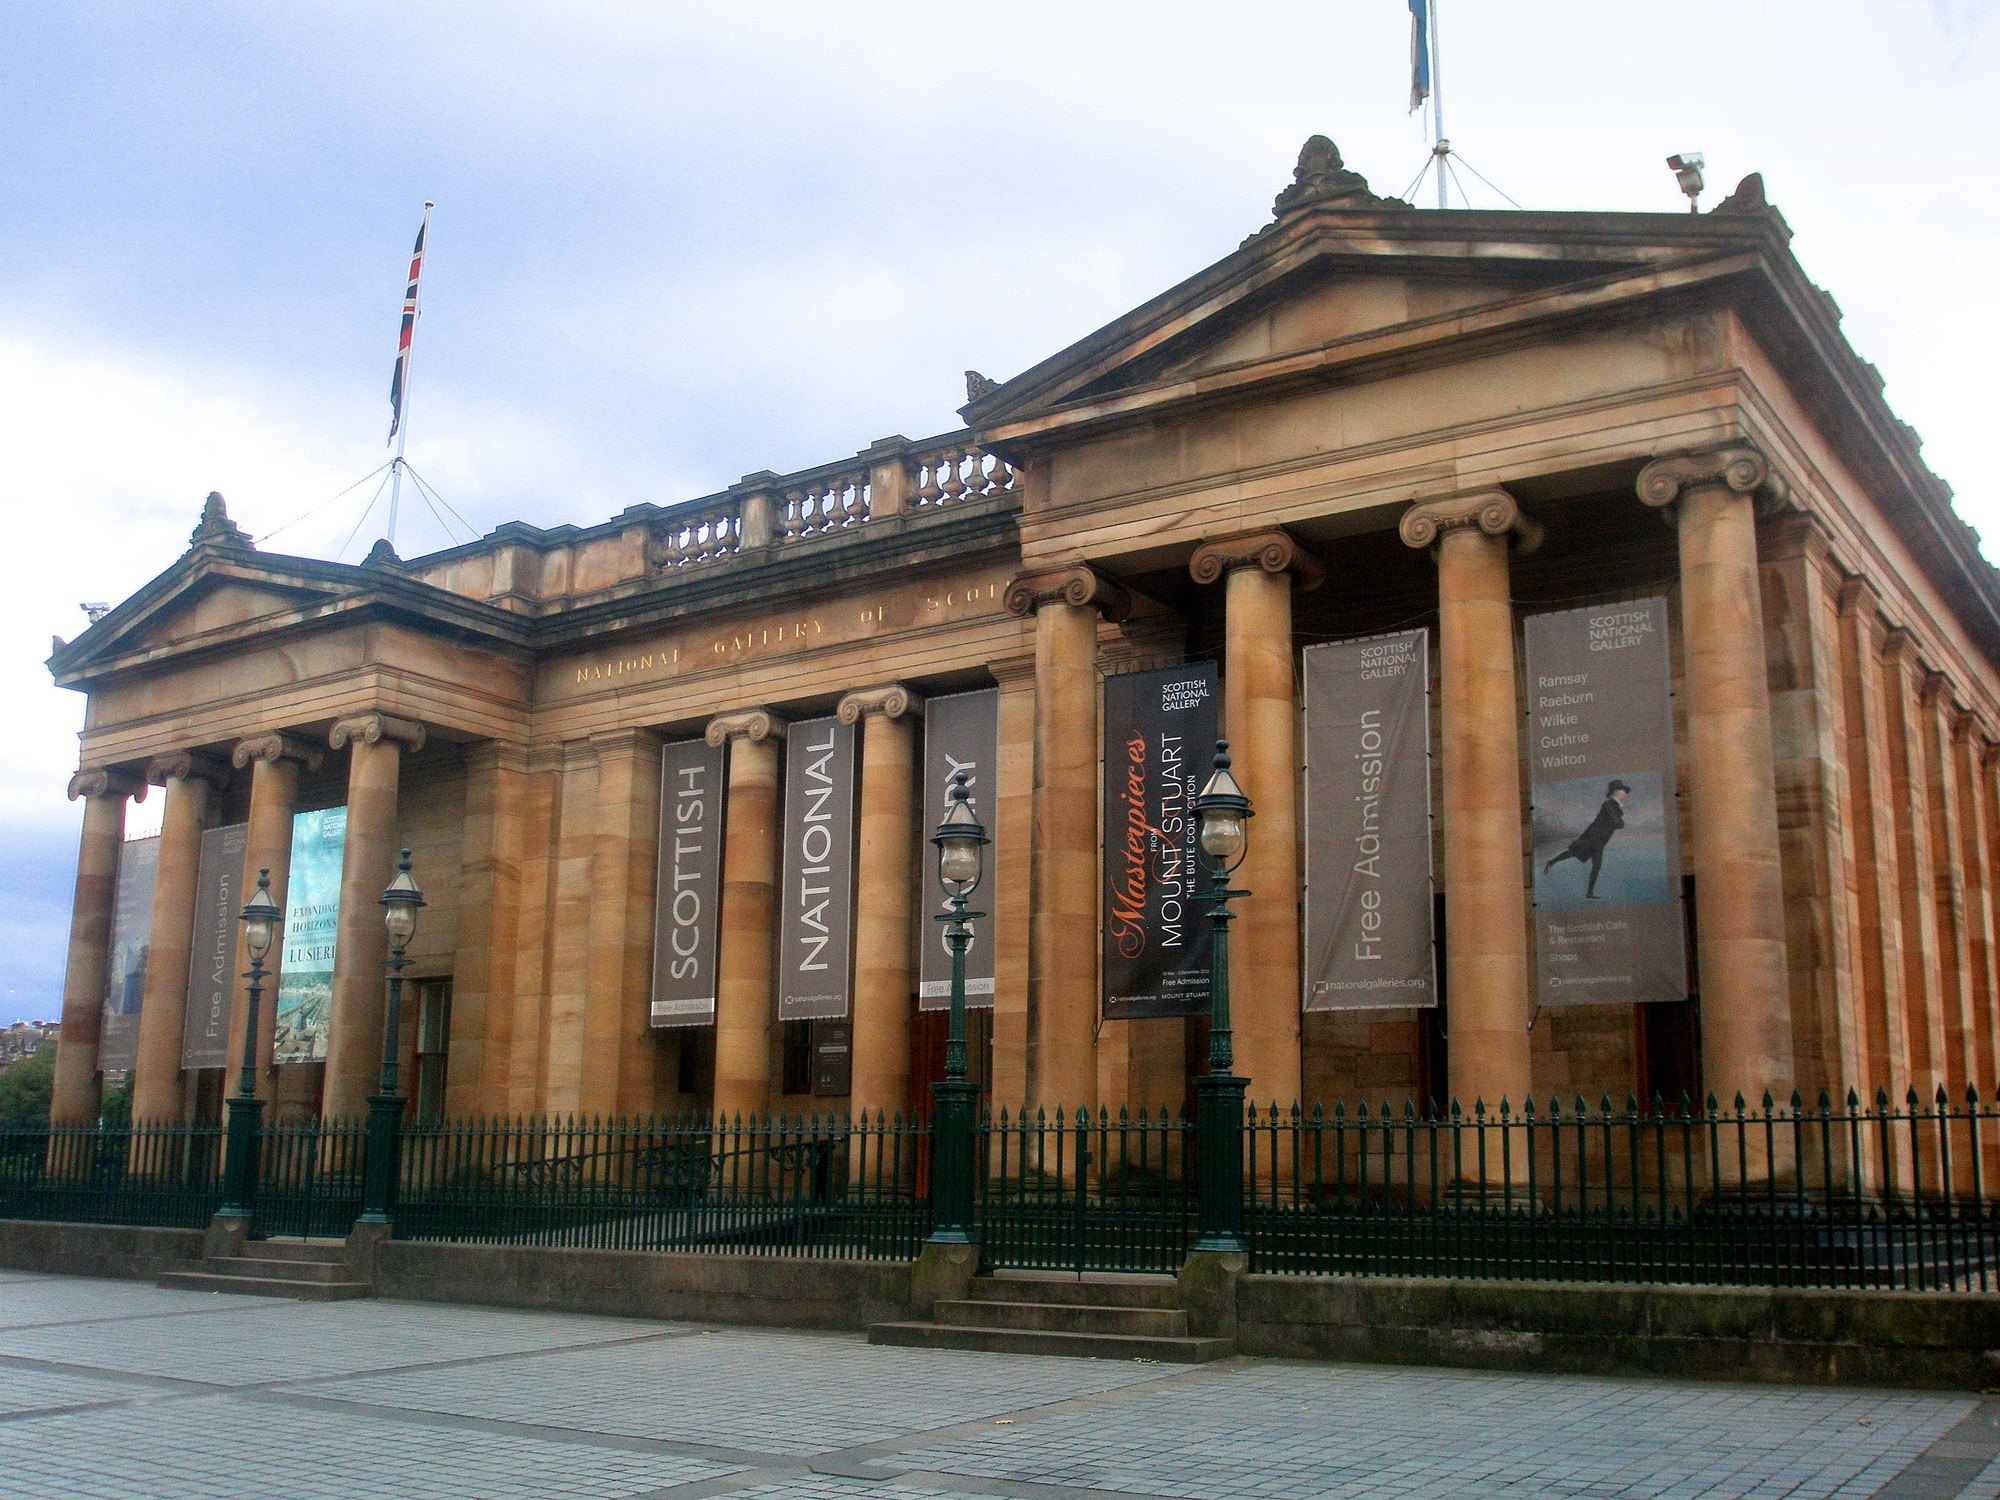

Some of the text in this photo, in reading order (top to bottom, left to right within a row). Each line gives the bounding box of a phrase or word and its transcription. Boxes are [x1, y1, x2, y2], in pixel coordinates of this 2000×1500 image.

[1589, 610, 1650, 630] SCOTTISH
[1589, 622, 1657, 641] NATIONAL
[576, 648, 679, 684] NATIONAL
[713, 619, 822, 654] GALLERY
[860, 606, 884, 623] OF
[1360, 640, 1414, 659] SCOTTISH
[1589, 634, 1643, 652] GALLERY
[1360, 652, 1418, 670] NATIONAL
[1361, 663, 1408, 681] GALLERY
[1538, 672, 1589, 689] Ramsay
[1162, 679, 1206, 694] SCOTTISH
[1162, 688, 1210, 703] NATIONAL
[1162, 698, 1201, 712] GALLERY
[1538, 691, 1594, 709] Raeburn
[1539, 713, 1579, 728] Wilkie
[1540, 732, 1590, 749] Guthrie
[1541, 754, 1586, 769] Walton
[1186, 775, 1196, 844] COLLCTION
[1150, 828, 1158, 852] FROM
[1161, 733, 1183, 947] MOUNT STUART
[1353, 708, 1382, 960] Free Admission
[799, 727, 835, 971] NATIONAL
[1109, 729, 1146, 959] Masterpieces
[1186, 847, 1196, 875] BUTE
[670, 766, 705, 980] SCOTTISH
[211, 873, 230, 985] Admission
[292, 919, 337, 933] HORIZONS
[290, 945, 335, 963] LUSIERI
[926, 984, 945, 995] Free
[1177, 977, 1210, 985] Admission
[1330, 977, 1425, 993] nationalgalleries.org
[206, 991, 224, 1037] Free
